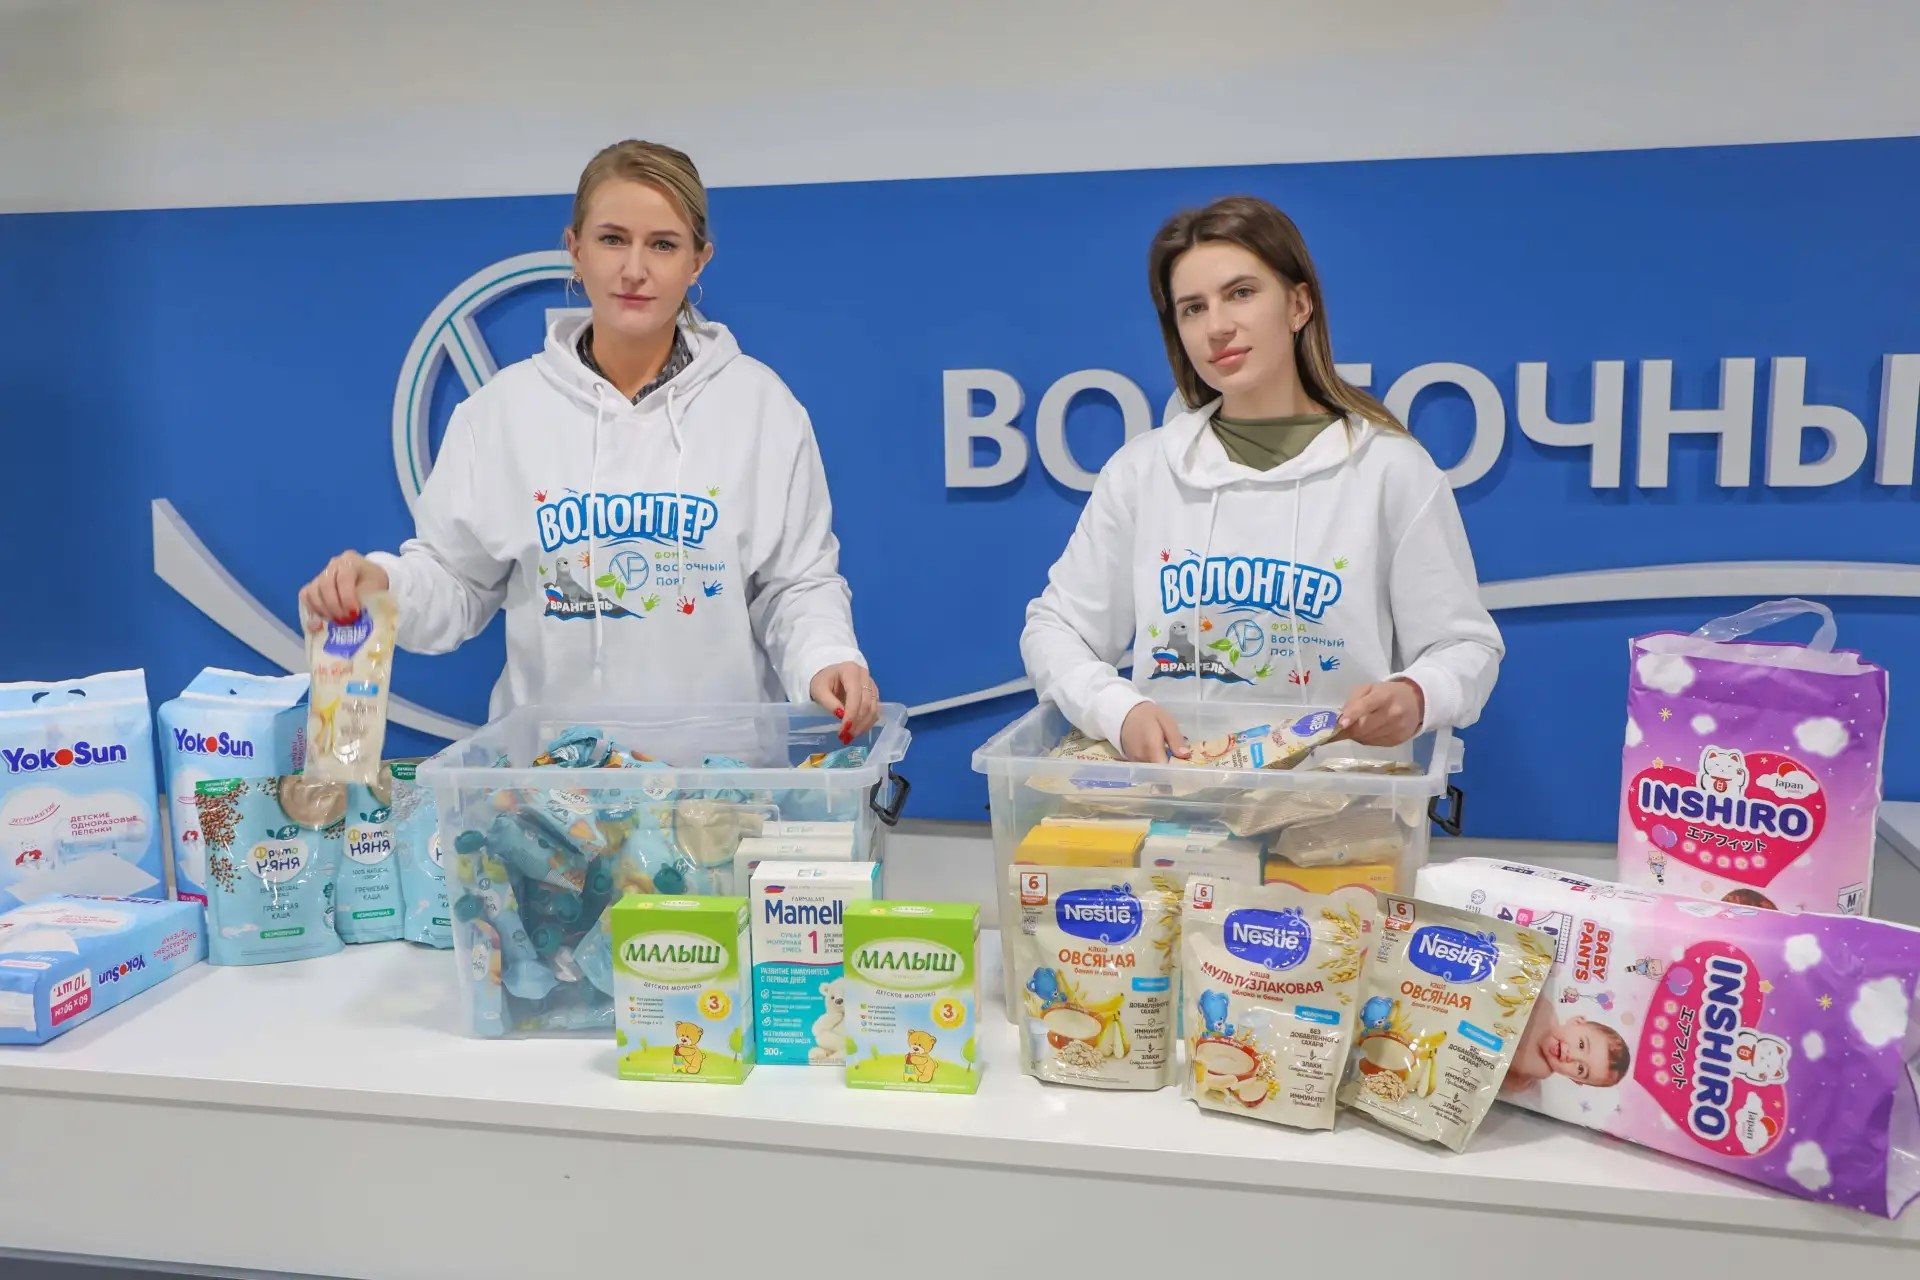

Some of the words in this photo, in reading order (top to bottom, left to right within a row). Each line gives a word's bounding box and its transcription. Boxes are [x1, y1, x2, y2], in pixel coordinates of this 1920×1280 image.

[943, 354, 1920, 491] ВООЧНЫ
[538, 493, 717, 551] ВОЛОНТЕР
[1162, 559, 1340, 617] ВОЛОНТЕР
[1160, 662, 1227, 674] ВРАНЕЛЬ
[174, 728, 254, 757] YokoSun
[2, 741, 127, 773] YokoSun
[1774, 778, 1804, 790] Japan
[70, 812, 110, 823] ДЕТСКИЕ
[1640, 780, 1809, 838] INSHIRO
[71, 815, 138, 830] ОДНОРАЗОВЫЕ
[71, 826, 112, 836] ПЕЛЕНКИ
[1687, 826, 1766, 852] エアフィット
[1028, 875, 1040, 890] 6
[1200, 887, 1207, 897] 6
[765, 900, 843, 925] Mamell
[1397, 903, 1406, 915] 6
[625, 943, 721, 964] МАЛЫШ
[807, 930, 818, 954] 1
[1575, 921, 1596, 981] PANTS
[857, 950, 956, 972] МАЛЫШ
[1058, 949, 1136, 968] ОВСЯНАЯ
[1592, 929, 1611, 980] BABY
[98, 954, 146, 985] YokoSun
[1201, 962, 1324, 995] МУЛЬТИЗЛАКОВАЯ
[75, 974, 87, 991] 10
[709, 995, 720, 1010] 3
[1400, 980, 1472, 1011] ОВСЯНАЯ
[943, 1004, 954, 1019] 3
[763, 1047, 779, 1056] 300
[1672, 1006, 1695, 1089] エアフィット
[1693, 959, 1744, 1136] INSHIRO
